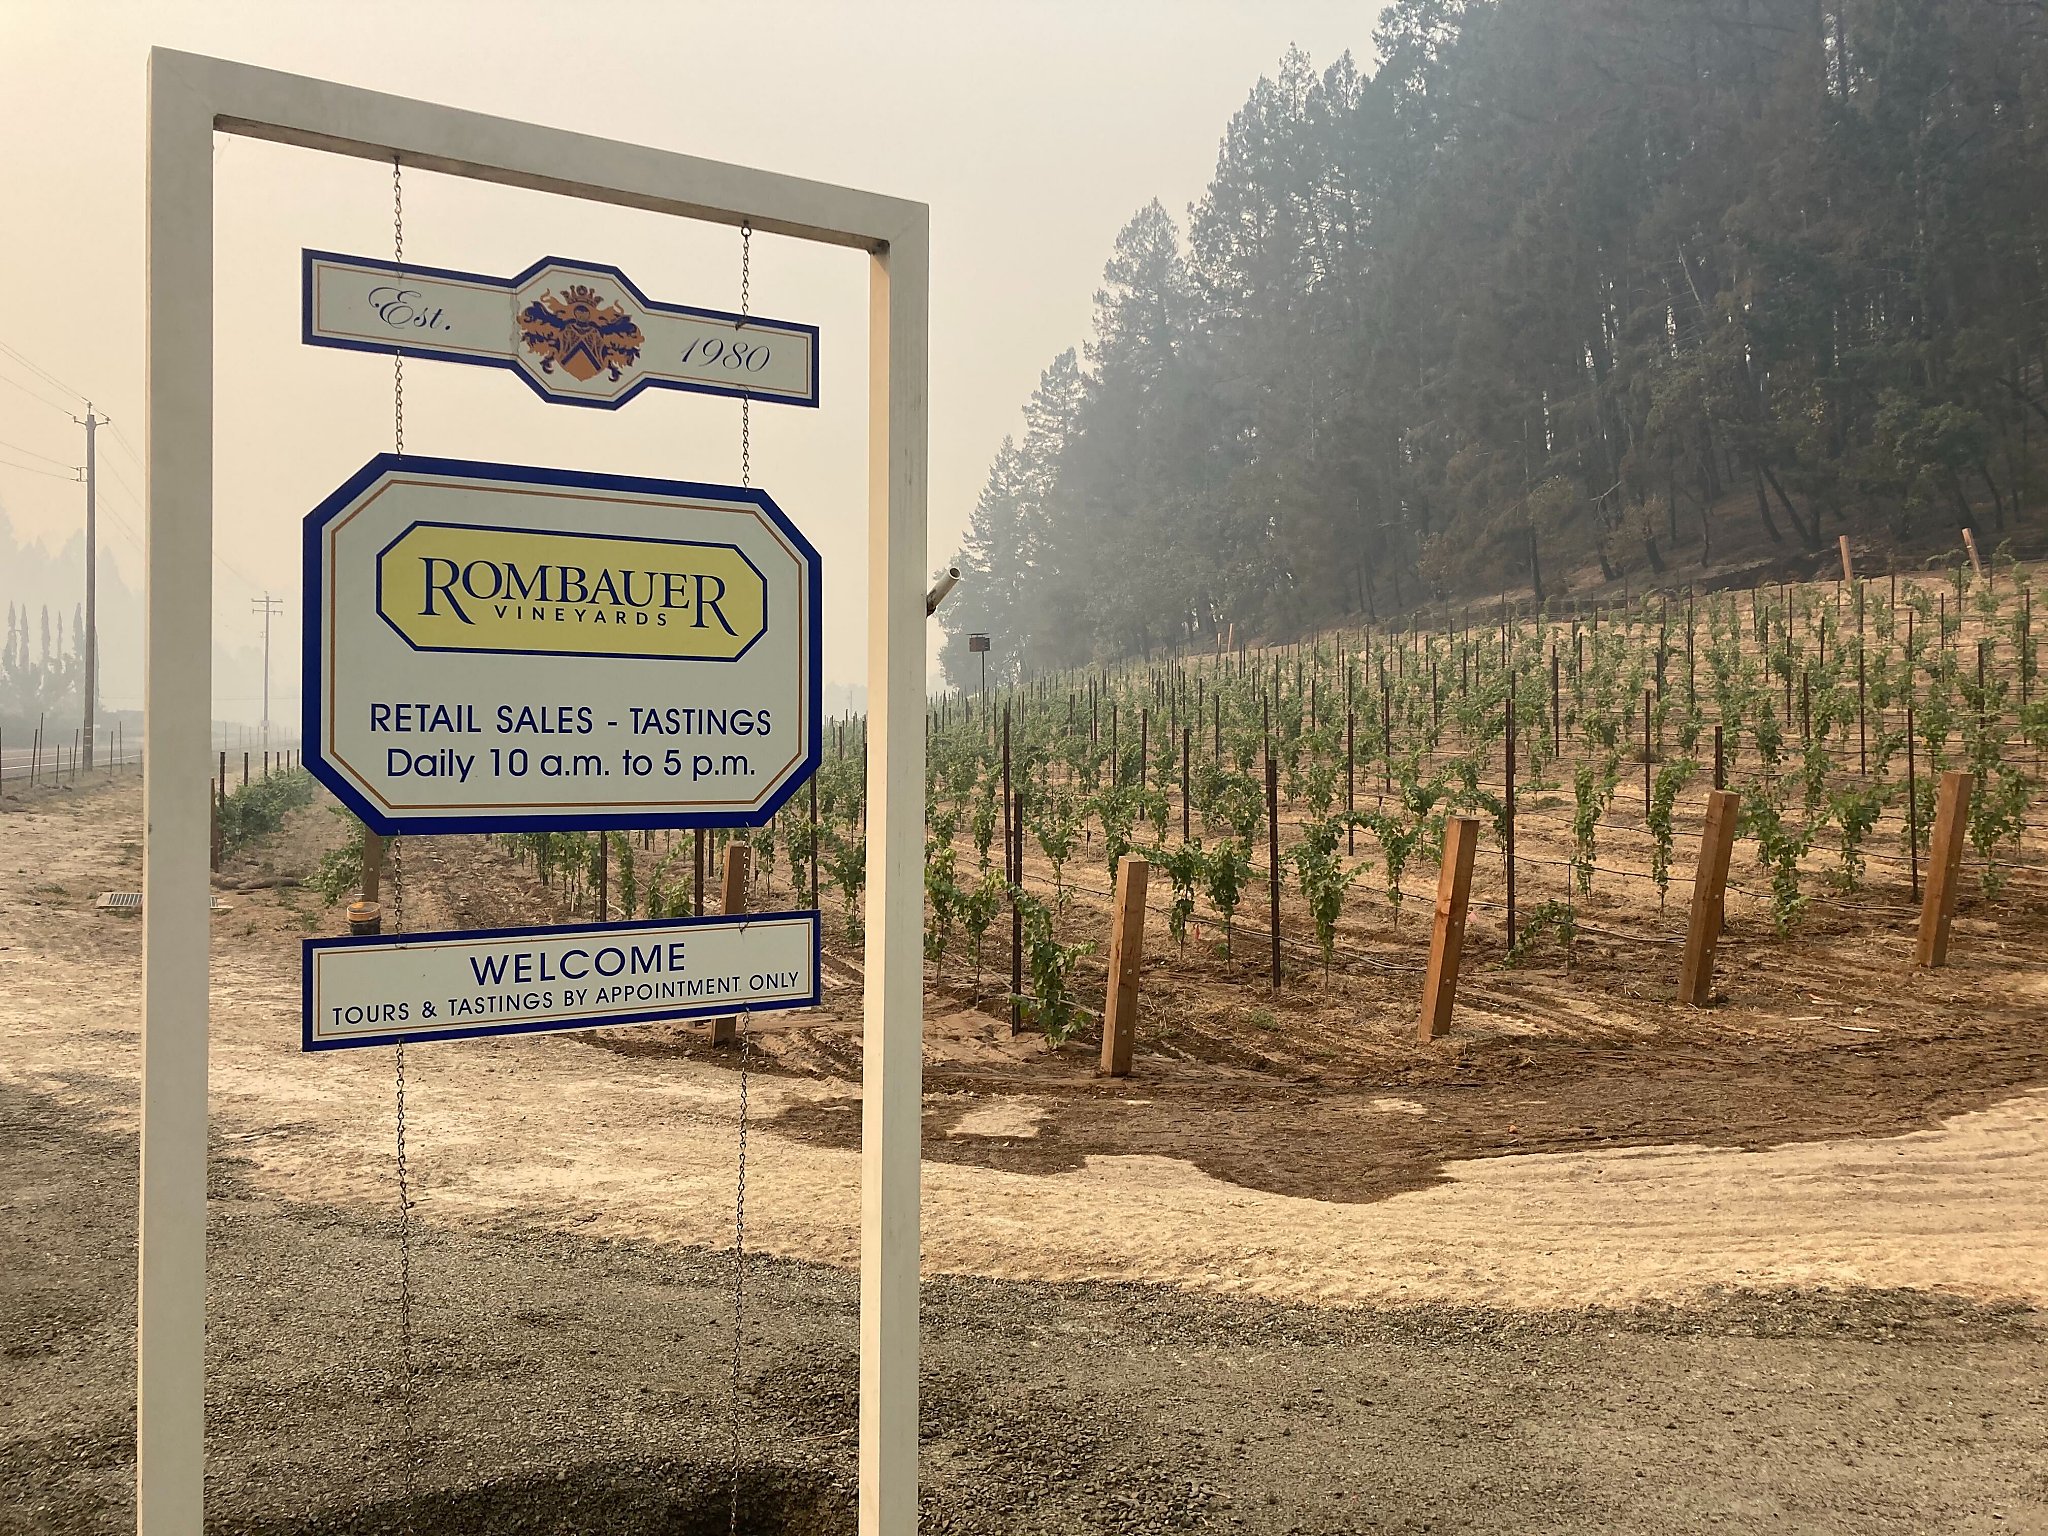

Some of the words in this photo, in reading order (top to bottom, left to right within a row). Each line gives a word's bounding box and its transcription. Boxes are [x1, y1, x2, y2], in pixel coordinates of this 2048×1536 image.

[367, 286, 451, 331] Est.
[680, 338, 771, 373] 1980
[417, 556, 740, 637] ROMBAUER
[493, 603, 668, 627] VINEYARDS
[370, 703, 481, 734] RETAIL
[496, 706, 593, 735] SALES
[629, 708, 771, 736] TASTINGS
[387, 748, 475, 783] Daily
[490, 748, 528, 777] 10
[538, 755, 610, 777] a.m.
[623, 749, 653, 777] to
[663, 750, 681, 776] 5
[692, 754, 756, 781] p.m.
[469, 942, 686, 986] WELCOME
[332, 1002, 410, 1026] TOURS
[421, 1000, 438, 1019] &
[447, 991, 553, 1017] TASTINGS
[564, 988, 588, 1008] BY
[595, 976, 741, 1004] APPOINTMENT
[749, 971, 800, 991] ONLY
